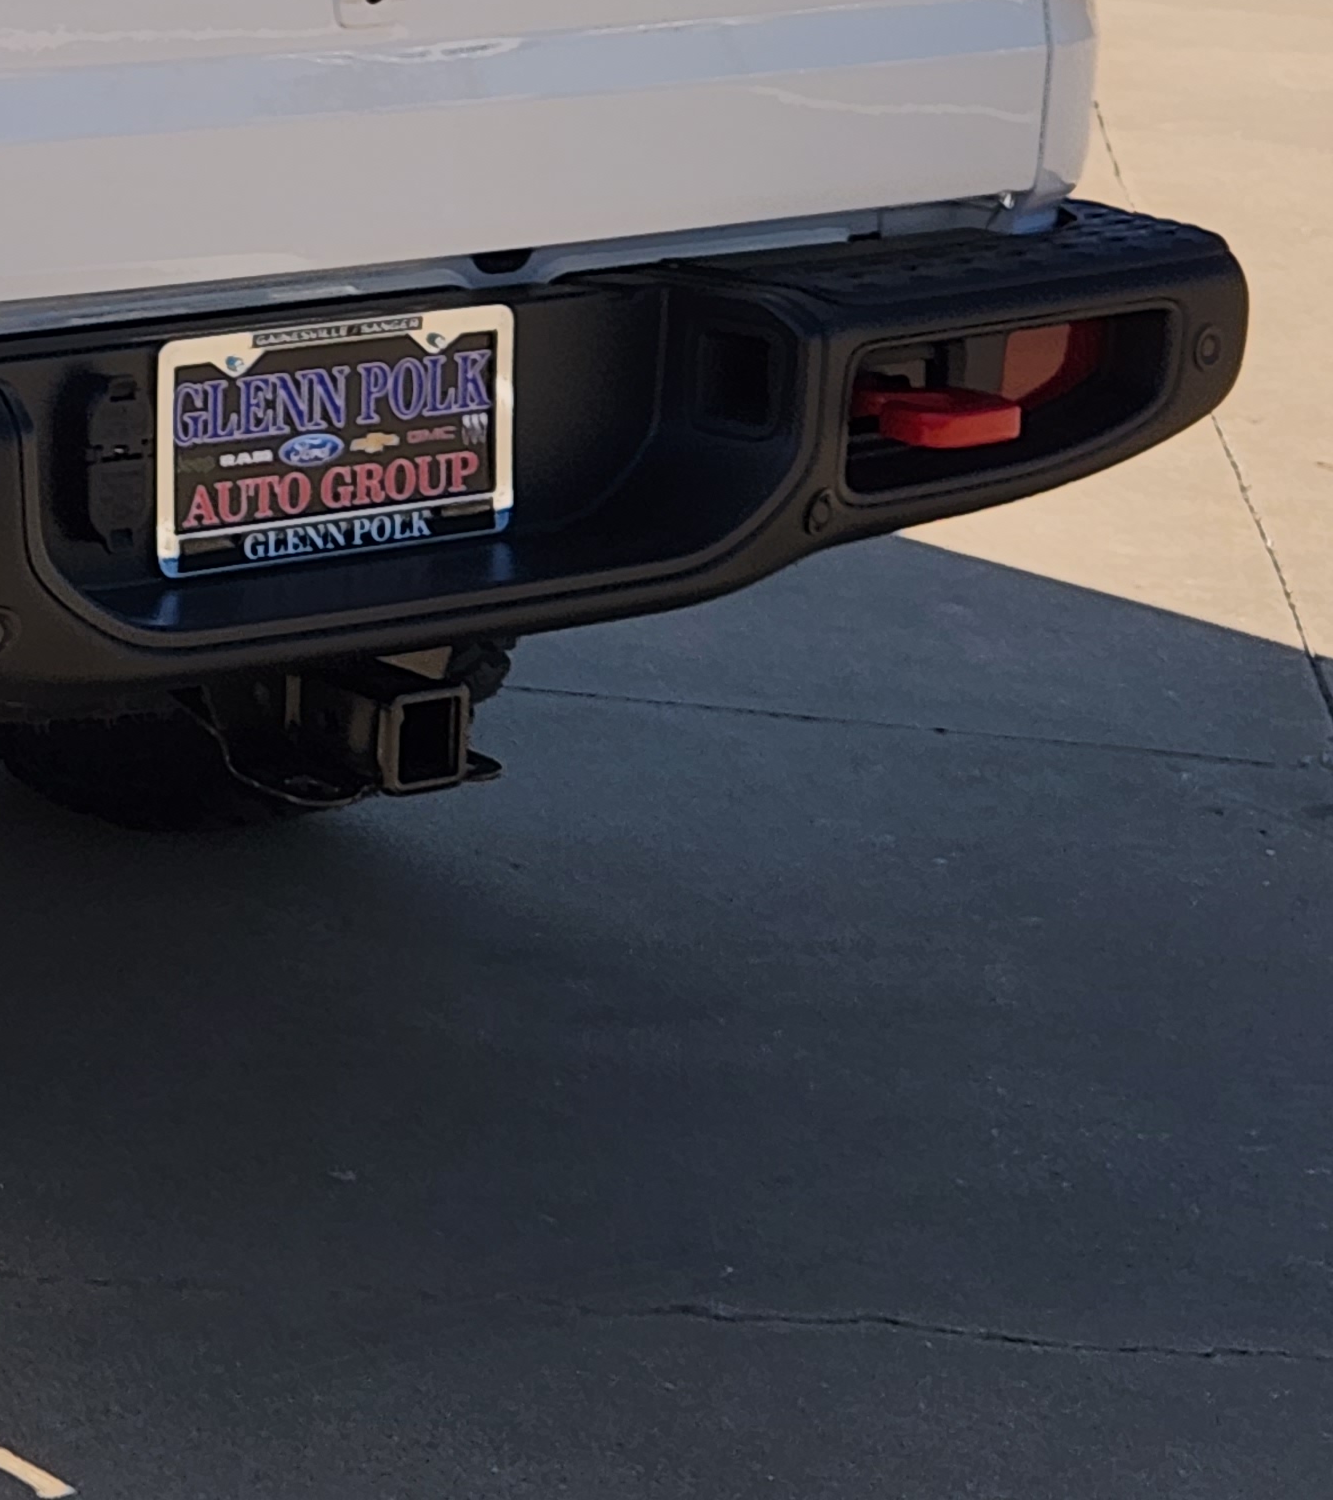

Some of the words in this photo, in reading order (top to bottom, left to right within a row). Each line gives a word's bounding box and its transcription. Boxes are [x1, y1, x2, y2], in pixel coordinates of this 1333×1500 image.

[173, 366, 351, 447] GLENN
[356, 349, 492, 424] POLK
[182, 471, 312, 528] AUTO
[320, 450, 479, 509] GROUP
[243, 521, 346, 560] GLENN
[352, 509, 433, 545] POLK
